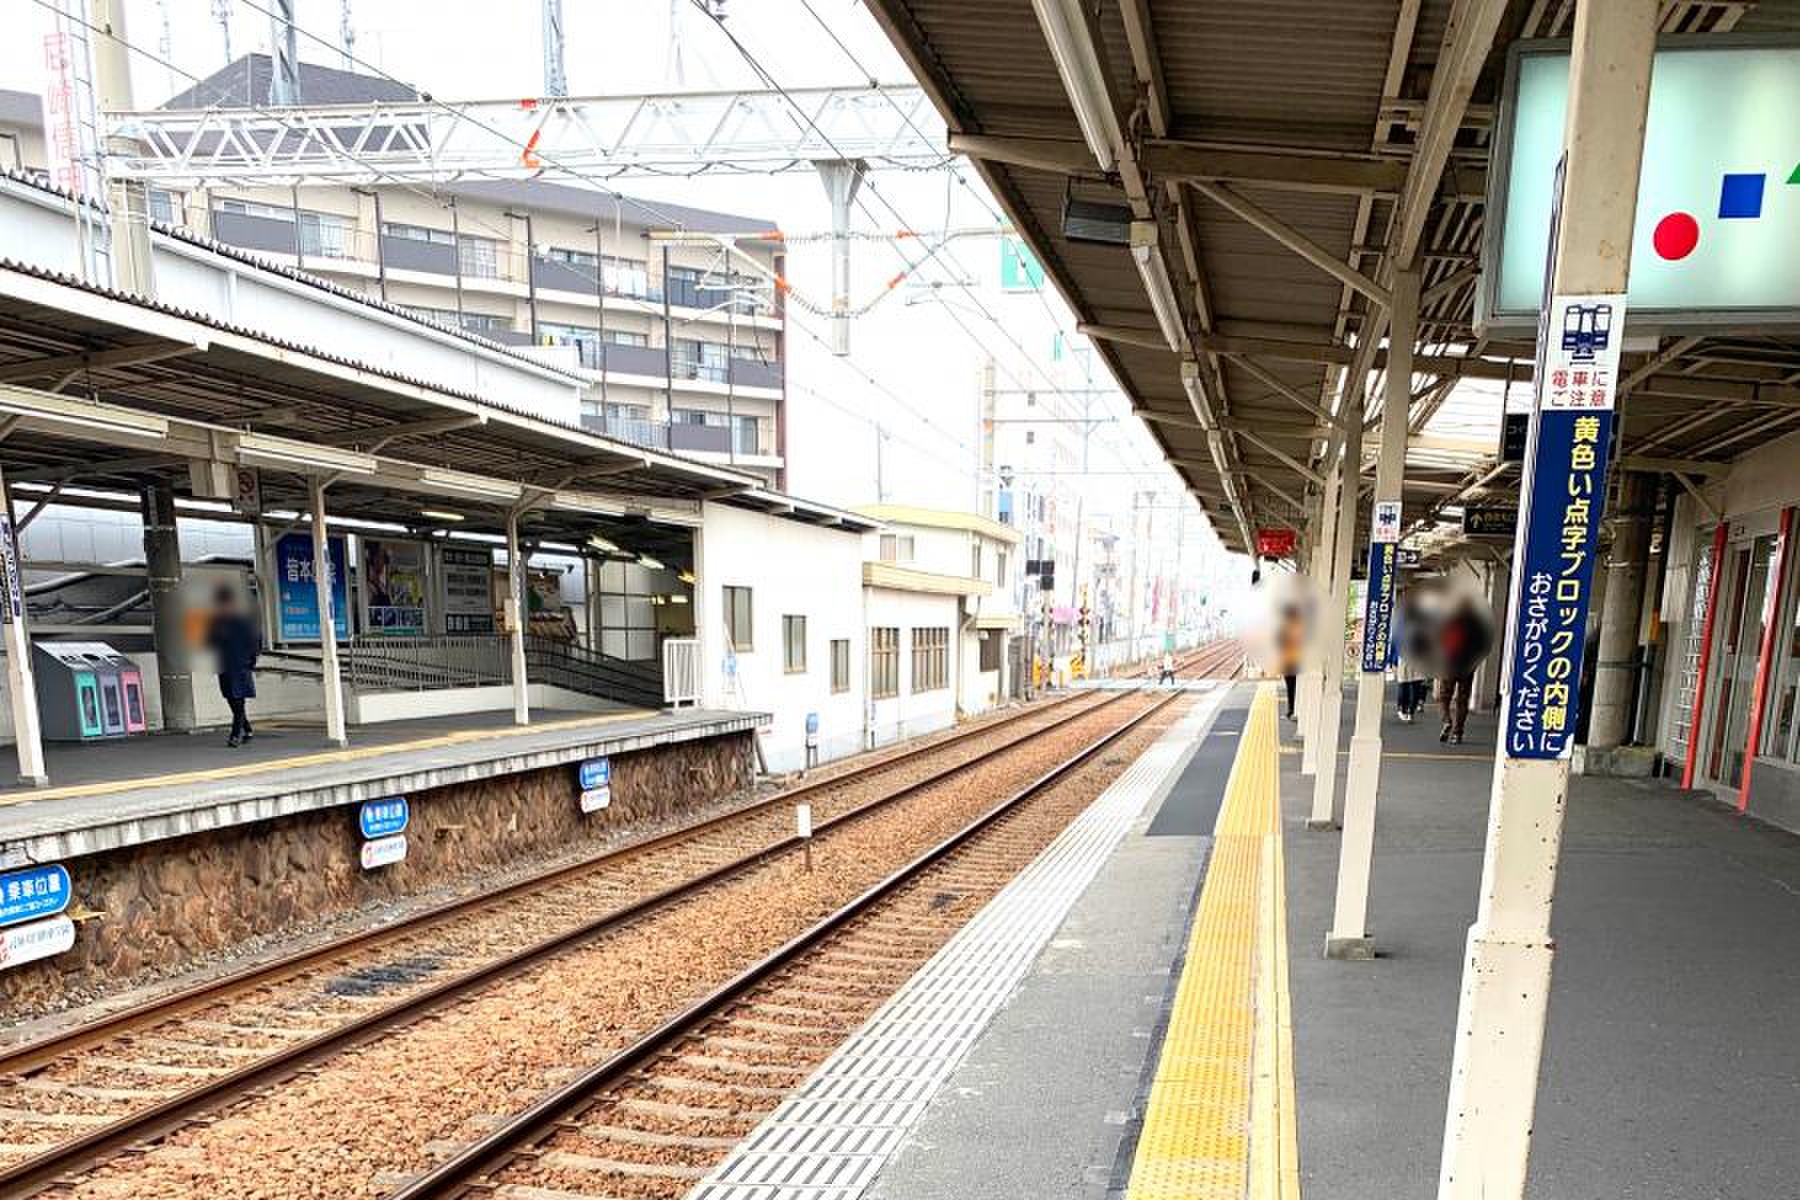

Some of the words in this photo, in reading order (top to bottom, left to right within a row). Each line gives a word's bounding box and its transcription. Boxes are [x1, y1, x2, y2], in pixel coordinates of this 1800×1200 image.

[1551, 389, 1607, 407] ご注意
[1552, 370, 1609, 387] 電車に
[1539, 416, 1600, 752] 黄色い点字ブロックの内側に
[1513, 572, 1552, 753] おさがりください
